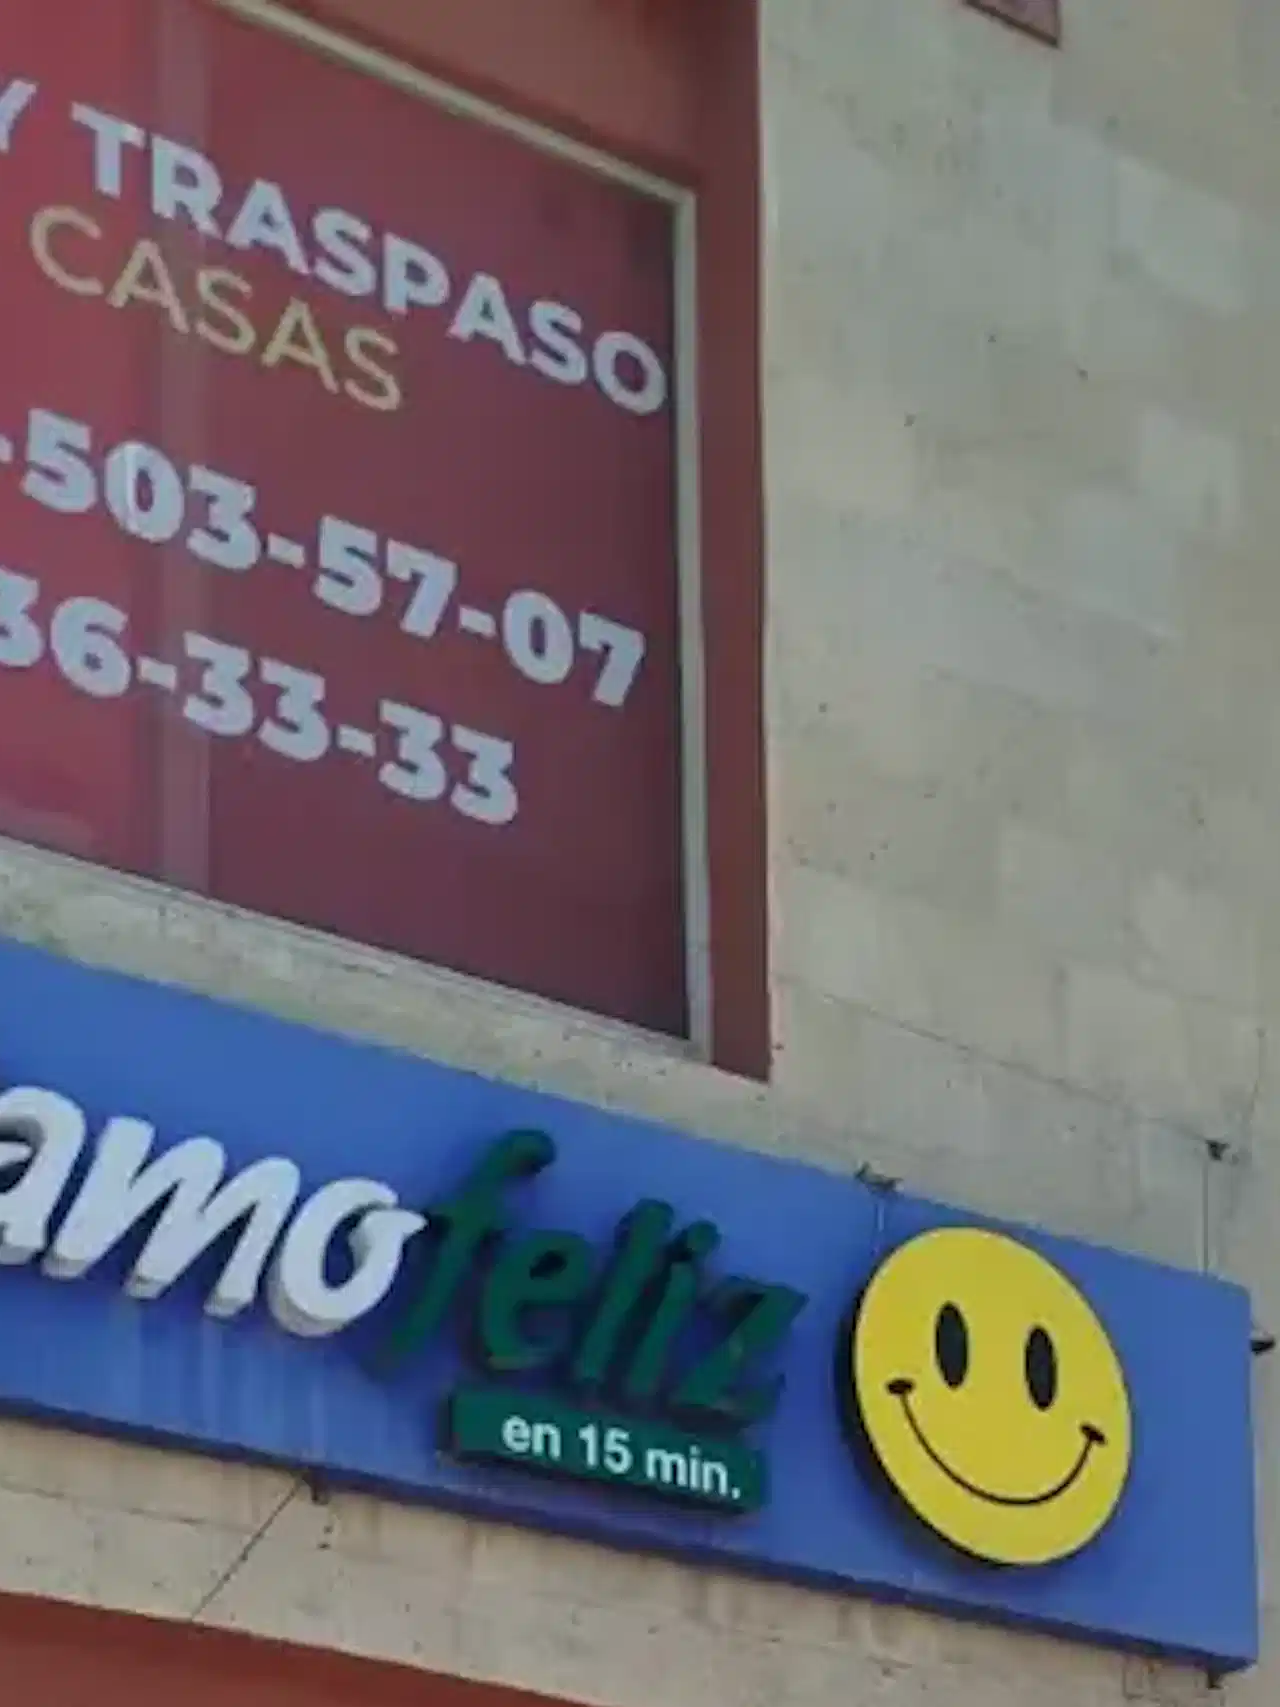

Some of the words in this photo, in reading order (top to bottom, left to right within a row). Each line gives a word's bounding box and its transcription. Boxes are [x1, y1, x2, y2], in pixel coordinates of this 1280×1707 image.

[28, 202, 404, 412] CASAS
[70, 100, 668, 416] TRASPASO
[500, 1412, 562, 1462] en
[578, 1422, 634, 1478] 15
[644, 1444, 742, 1500] min.
